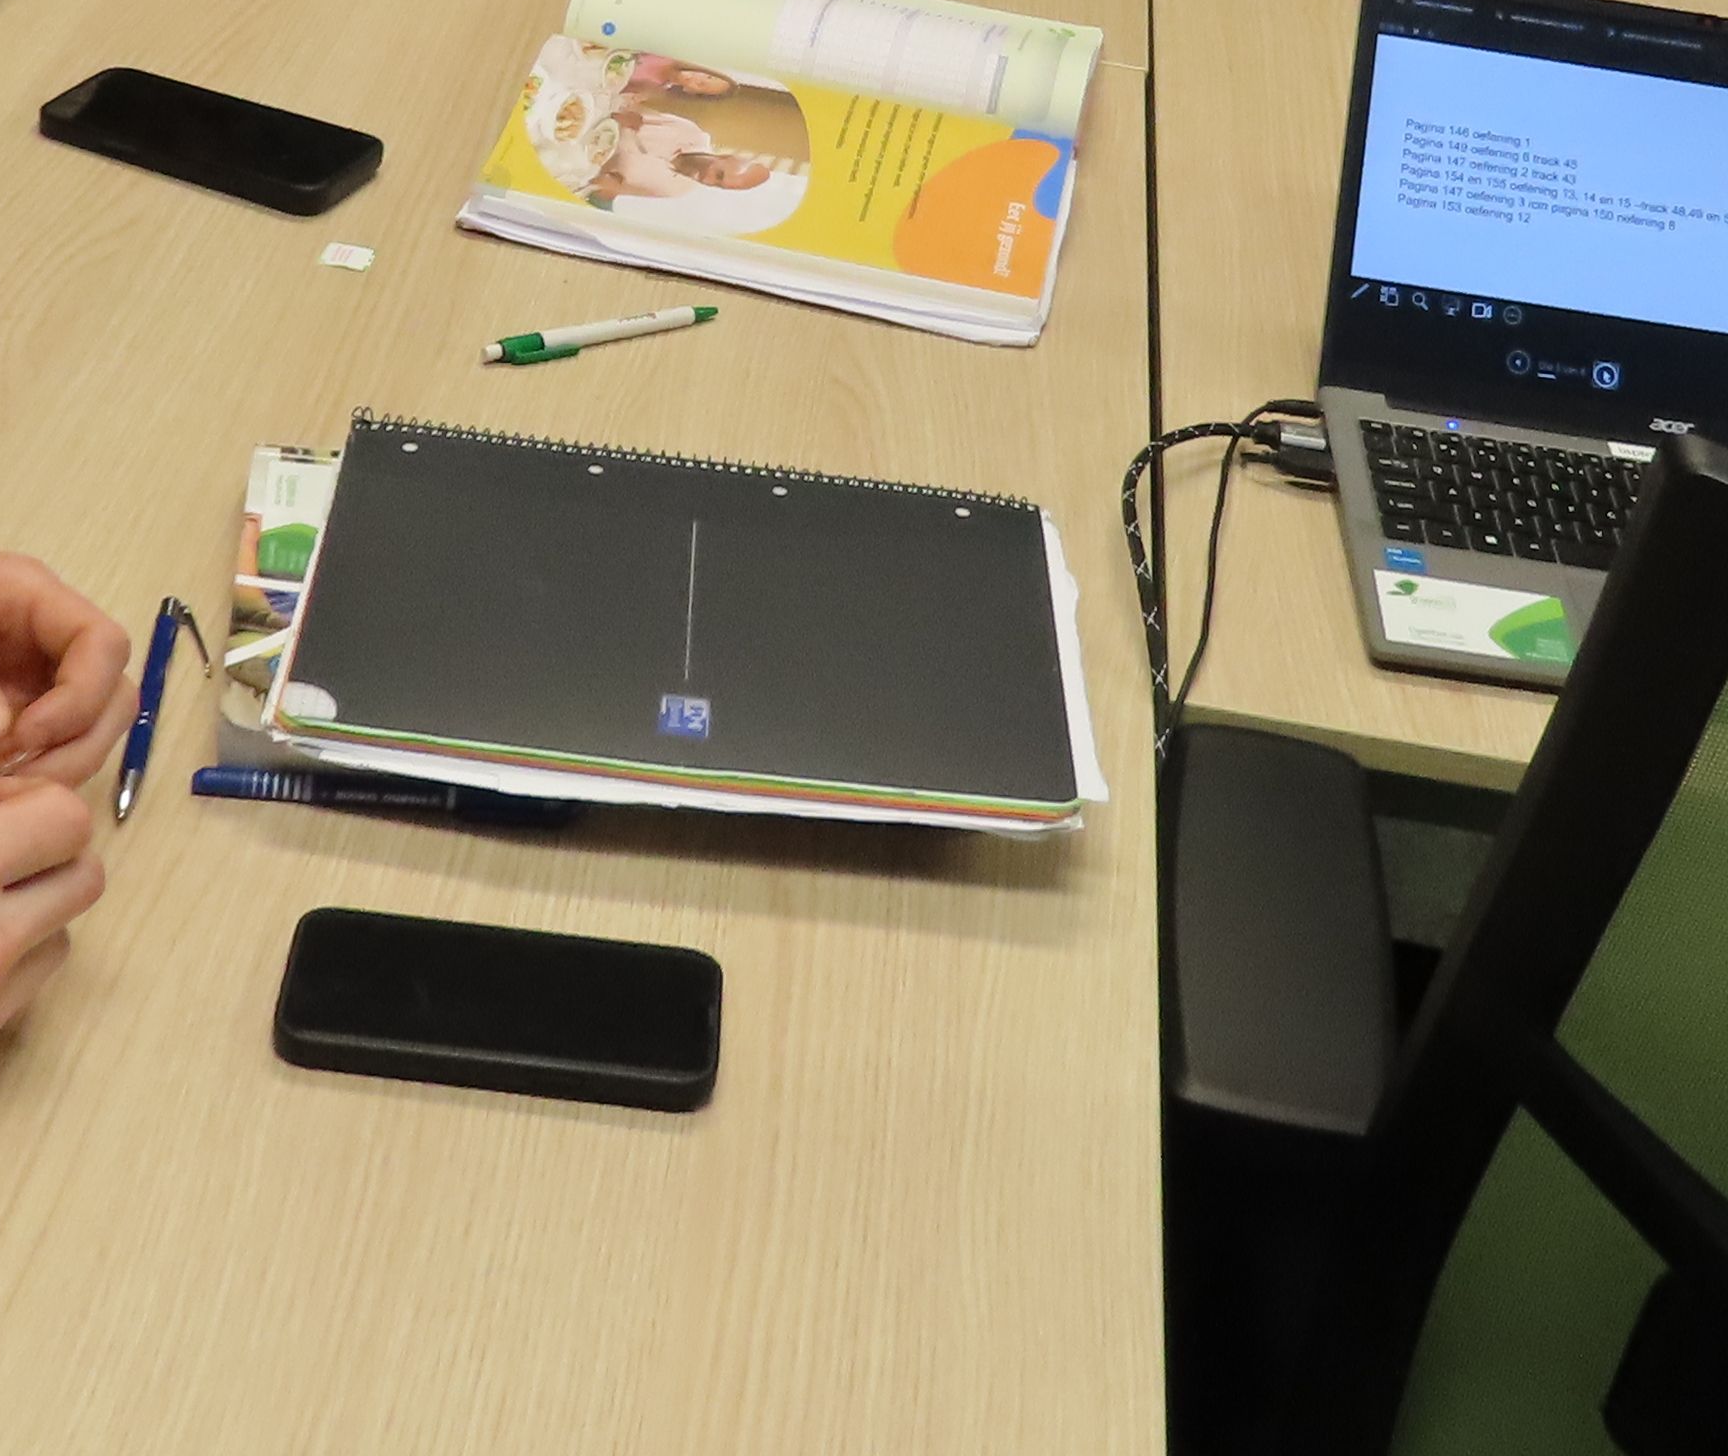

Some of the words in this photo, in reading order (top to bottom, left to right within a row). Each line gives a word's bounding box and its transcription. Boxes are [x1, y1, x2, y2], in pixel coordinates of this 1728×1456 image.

[1406, 119, 1445, 134] Pagina
[1404, 133, 1444, 150] Pagina
[1403, 149, 1442, 166] Pagina
[1401, 164, 1440, 180] Pagina
[1400, 179, 1439, 195] Pagina
[1398, 194, 1437, 209] Pagina
[1648, 417, 1695, 435] acer
